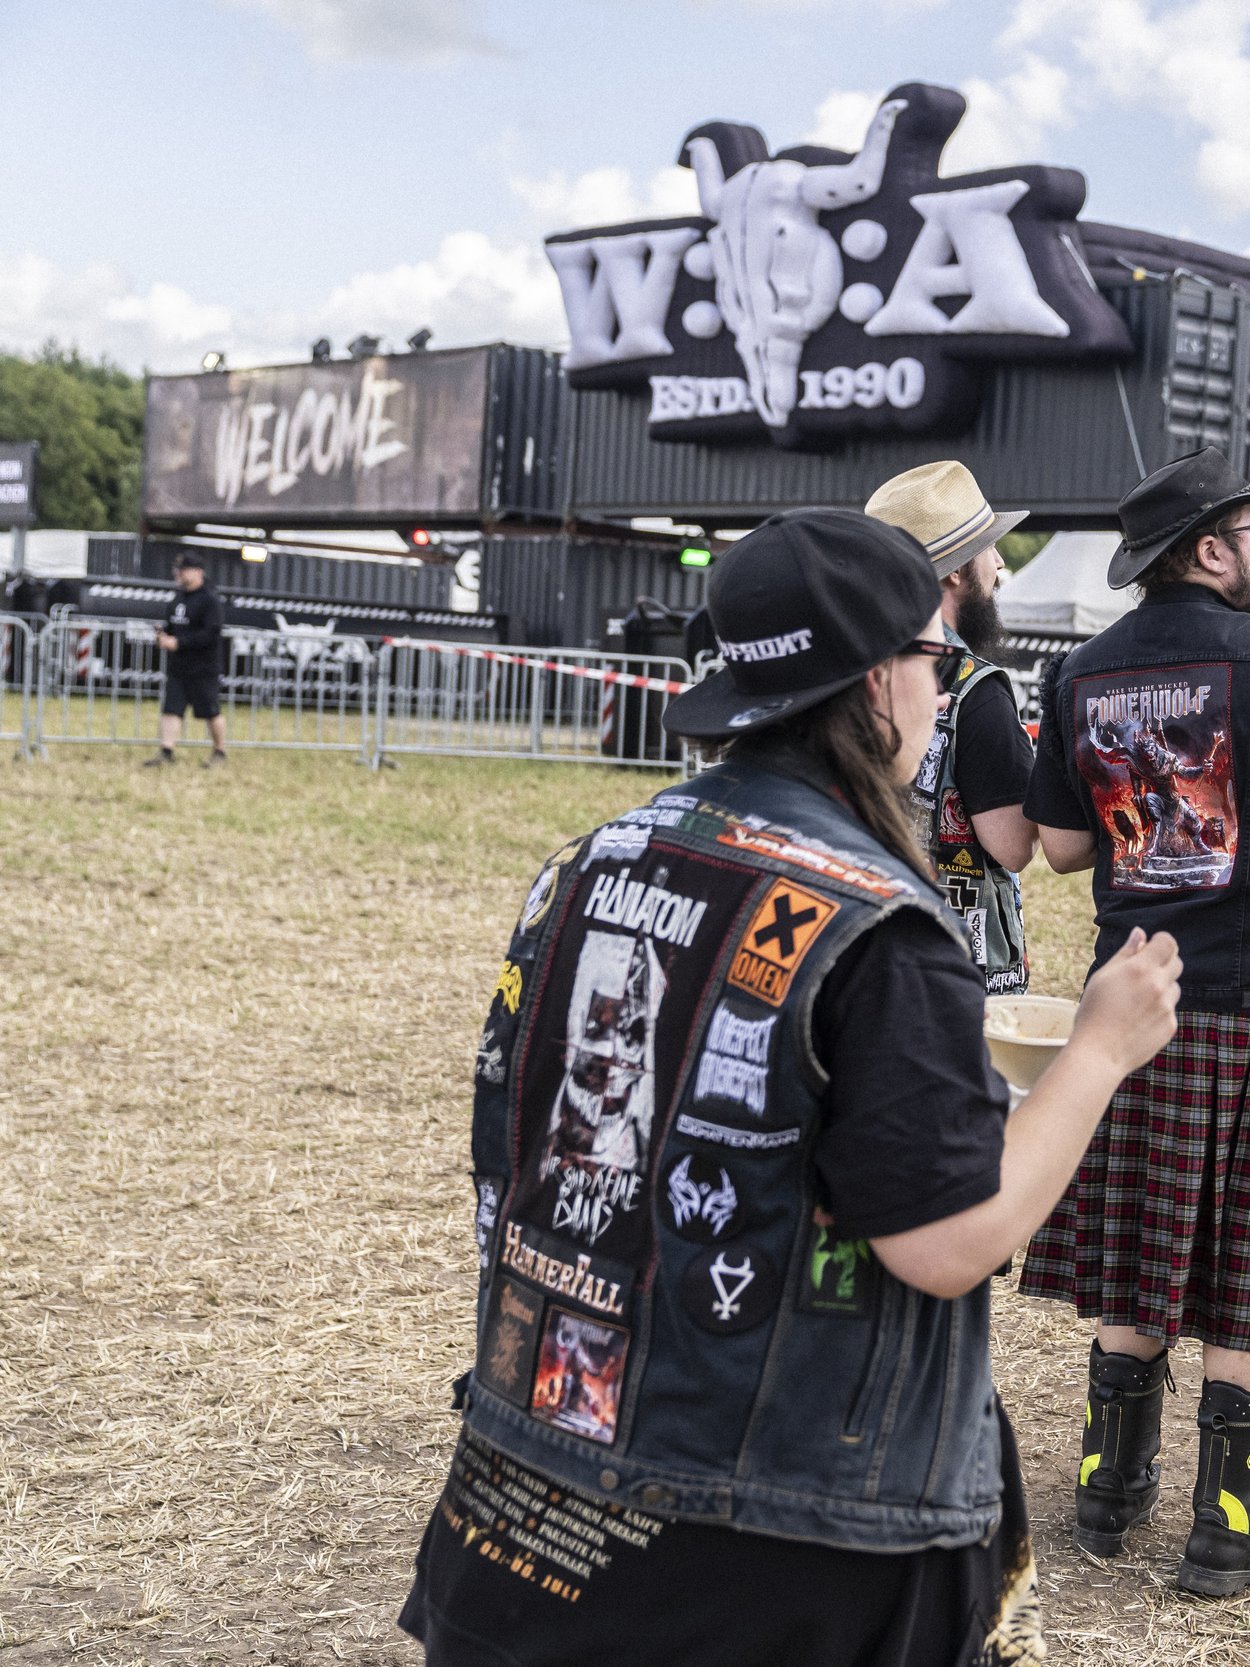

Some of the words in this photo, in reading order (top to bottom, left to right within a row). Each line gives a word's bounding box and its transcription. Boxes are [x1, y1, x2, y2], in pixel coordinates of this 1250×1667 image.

[799, 356, 925, 411] 1990
[213, 376, 409, 508] WELCOME
[1086, 685, 1211, 727] POWERWOLF
[1106, 686, 1125, 695] WAKE
[1158, 681, 1189, 689] WICKED
[734, 951, 790, 1001] OMEN
[502, 1220, 624, 1317] HAMMERFALL
[540, 1573, 582, 1603] JULI
